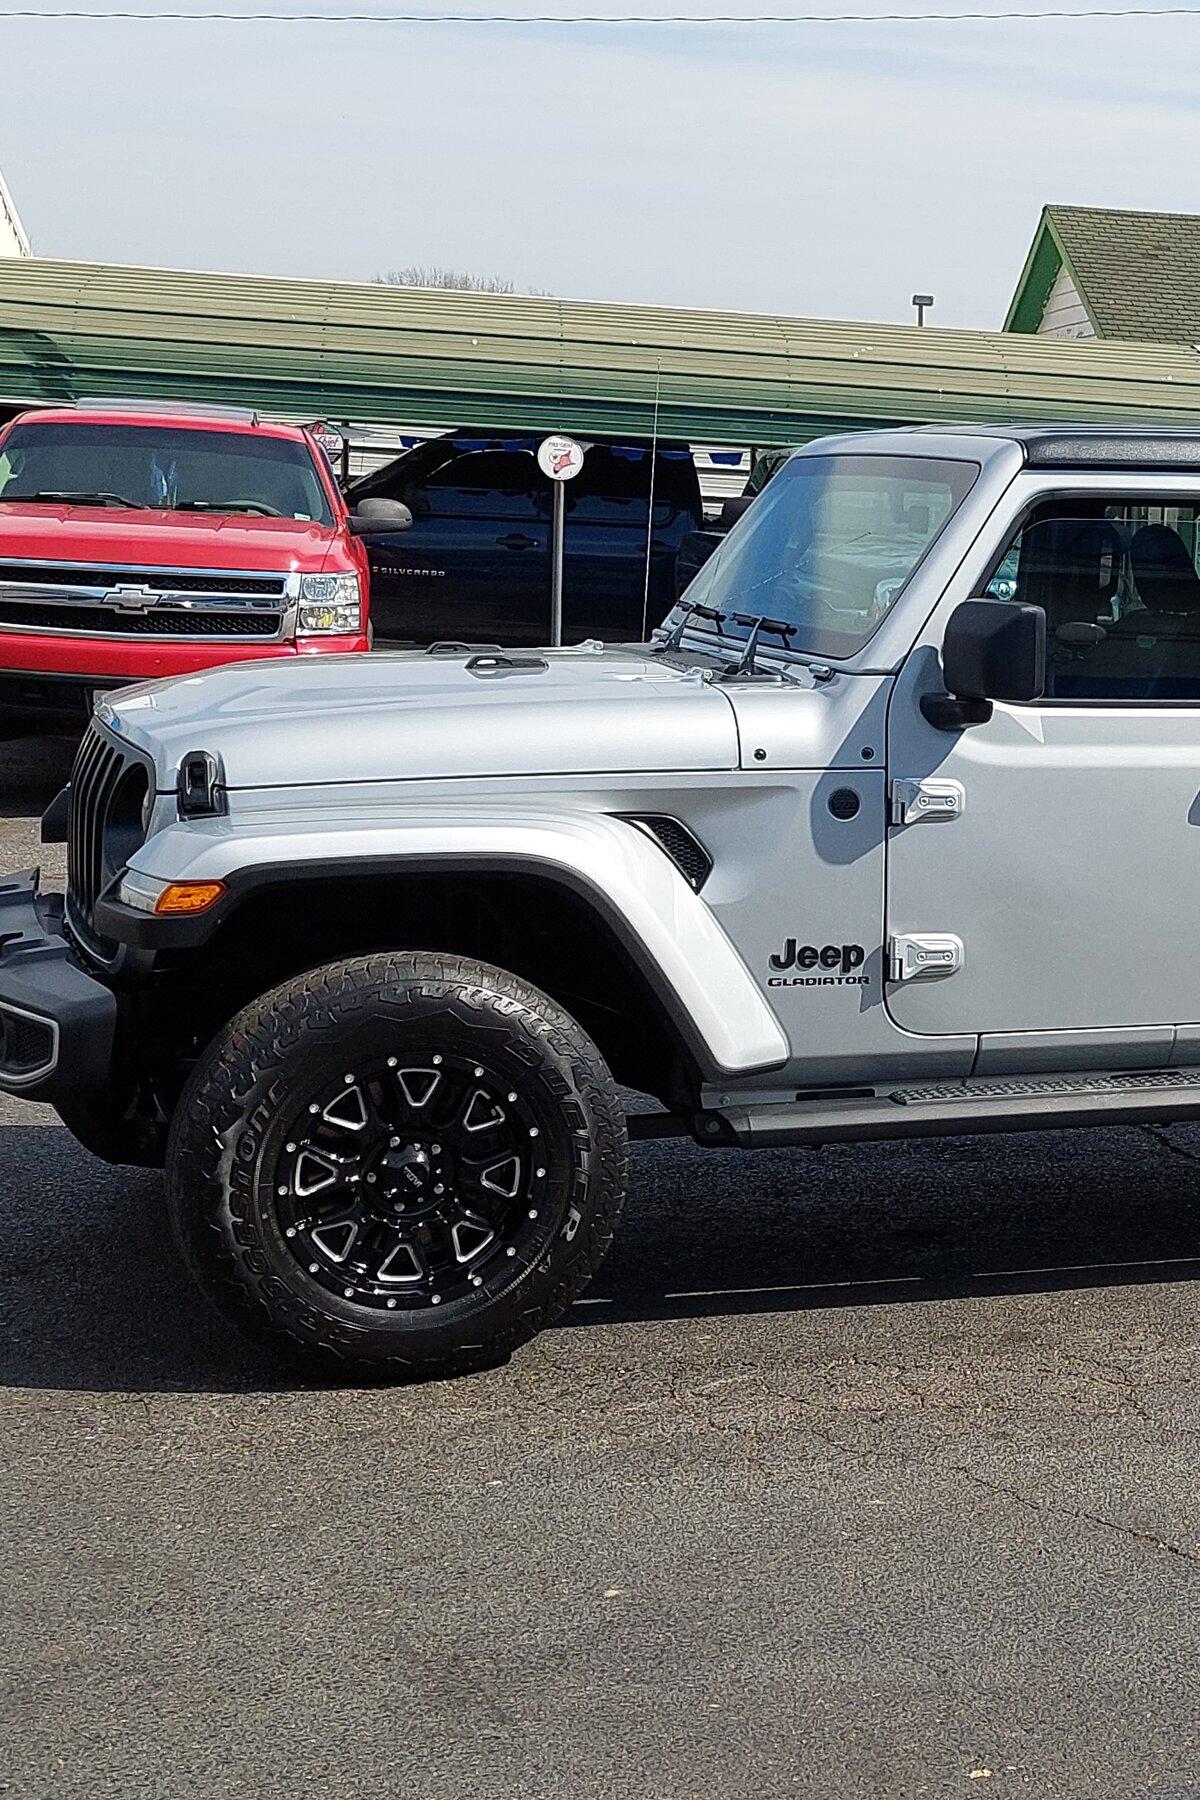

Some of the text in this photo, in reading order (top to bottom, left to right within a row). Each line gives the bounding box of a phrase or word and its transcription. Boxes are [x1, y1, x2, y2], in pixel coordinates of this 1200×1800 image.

[381, 567, 446, 577] SILVERADO
[769, 938, 865, 975] Jeep
[767, 976, 871, 988] GLADIATOR
